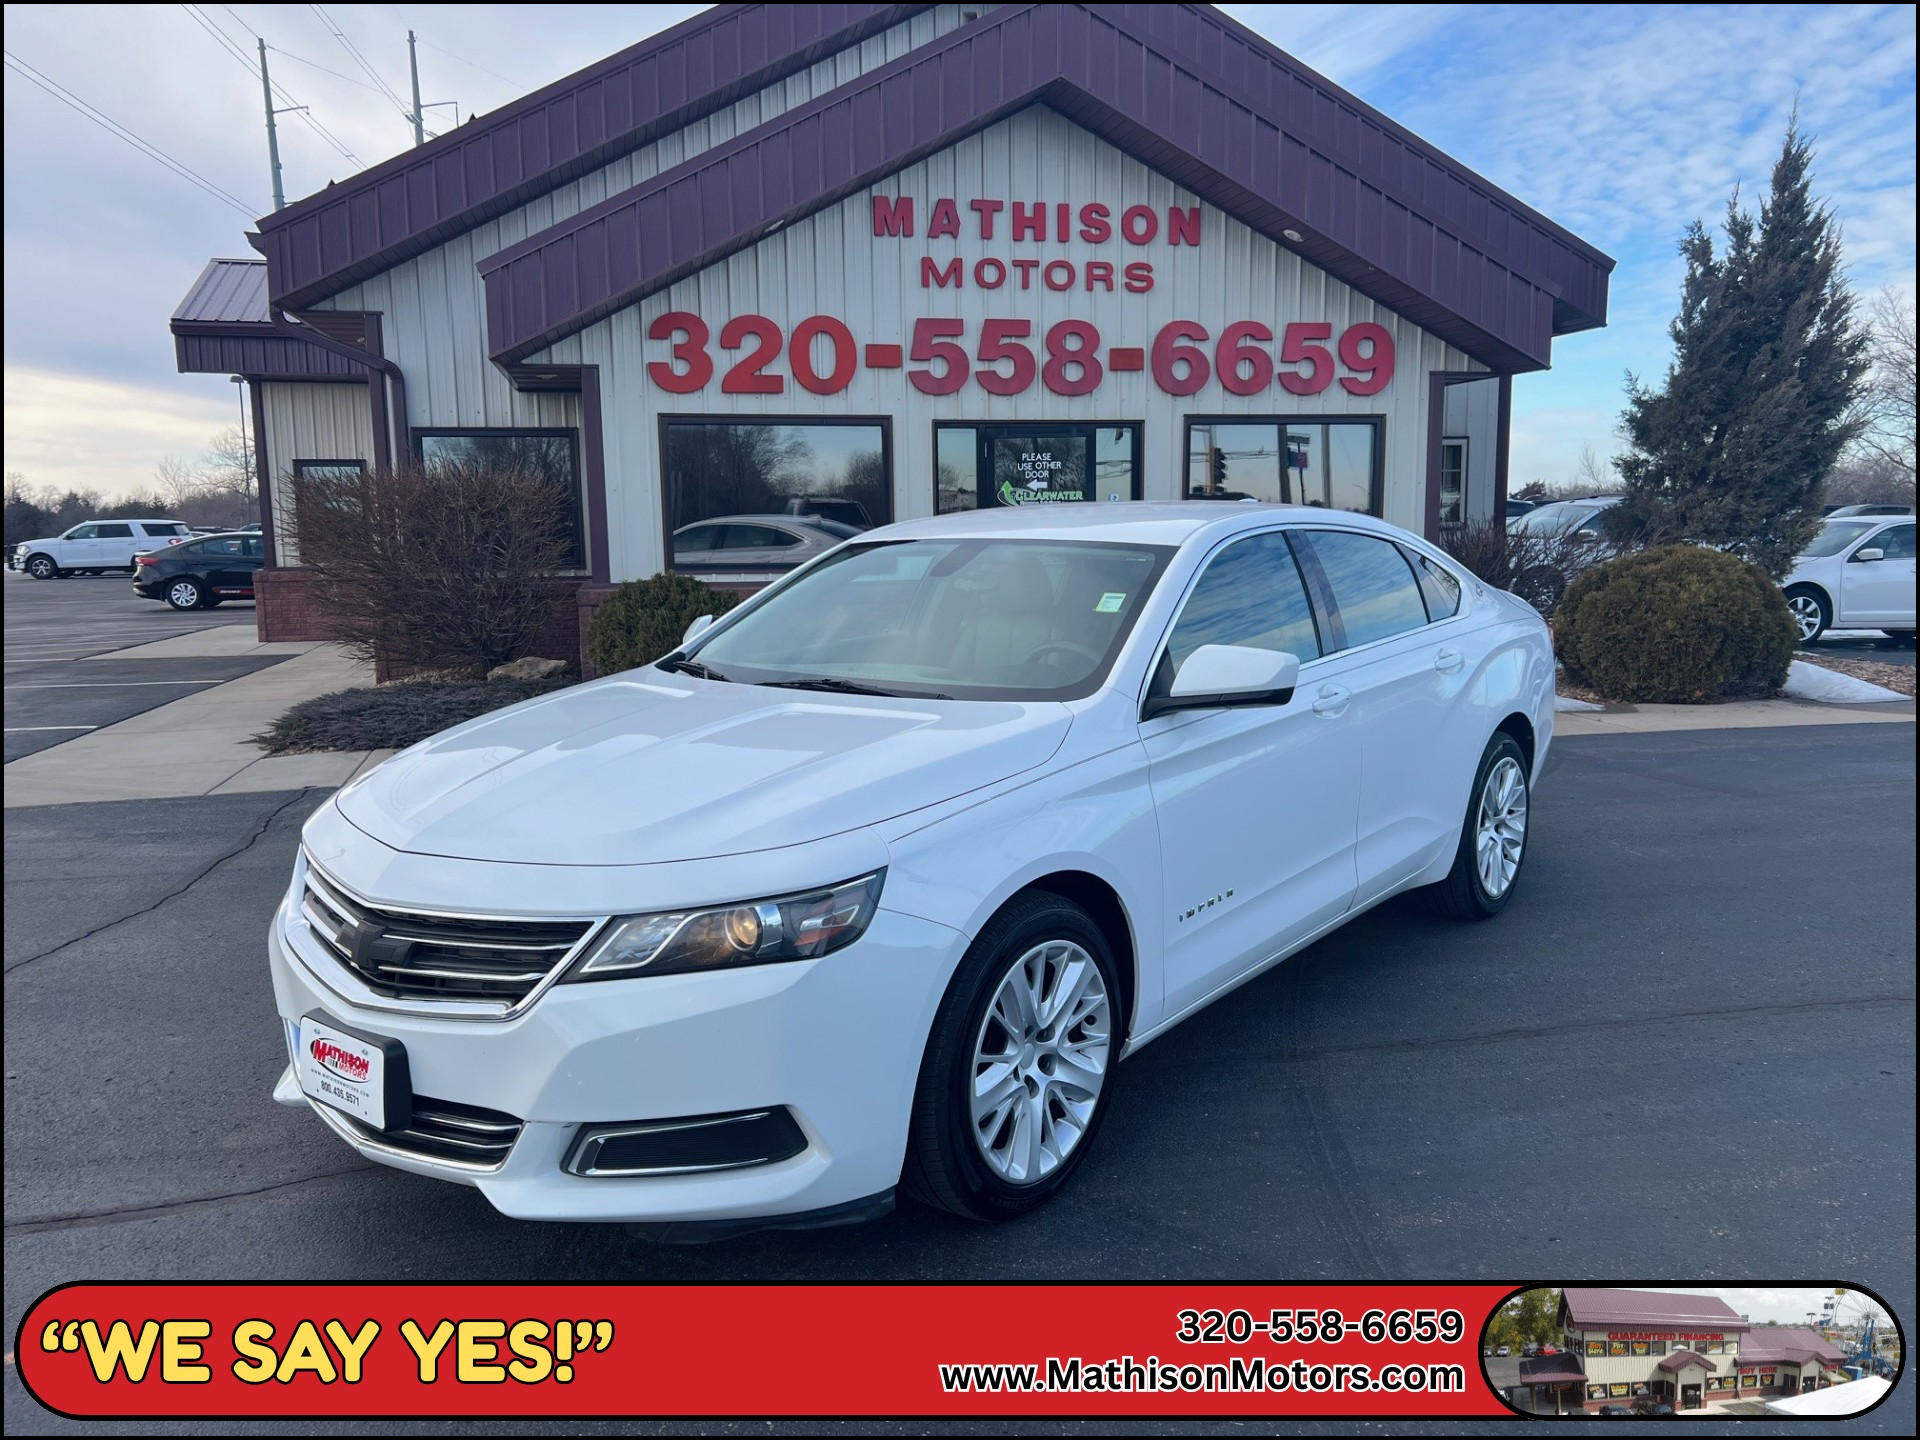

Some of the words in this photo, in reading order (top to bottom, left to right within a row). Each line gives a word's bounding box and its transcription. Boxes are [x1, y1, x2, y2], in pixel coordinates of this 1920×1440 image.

[872, 195, 1202, 247] MATHISON
[920, 256, 1156, 293] MOTORS
[647, 311, 1396, 397] 320-558-6659
[1017, 462, 1033, 471] USE
[1035, 461, 1062, 470] OTHER
[1022, 453, 1052, 461] PLEASE
[1025, 470, 1050, 479] DOOR
[1015, 490, 1083, 501] CLEARWATER
[313, 1039, 370, 1074] MATHISON
[338, 1062, 367, 1080] MOTORS
[320, 1080, 360, 1107] 800.435.9571
